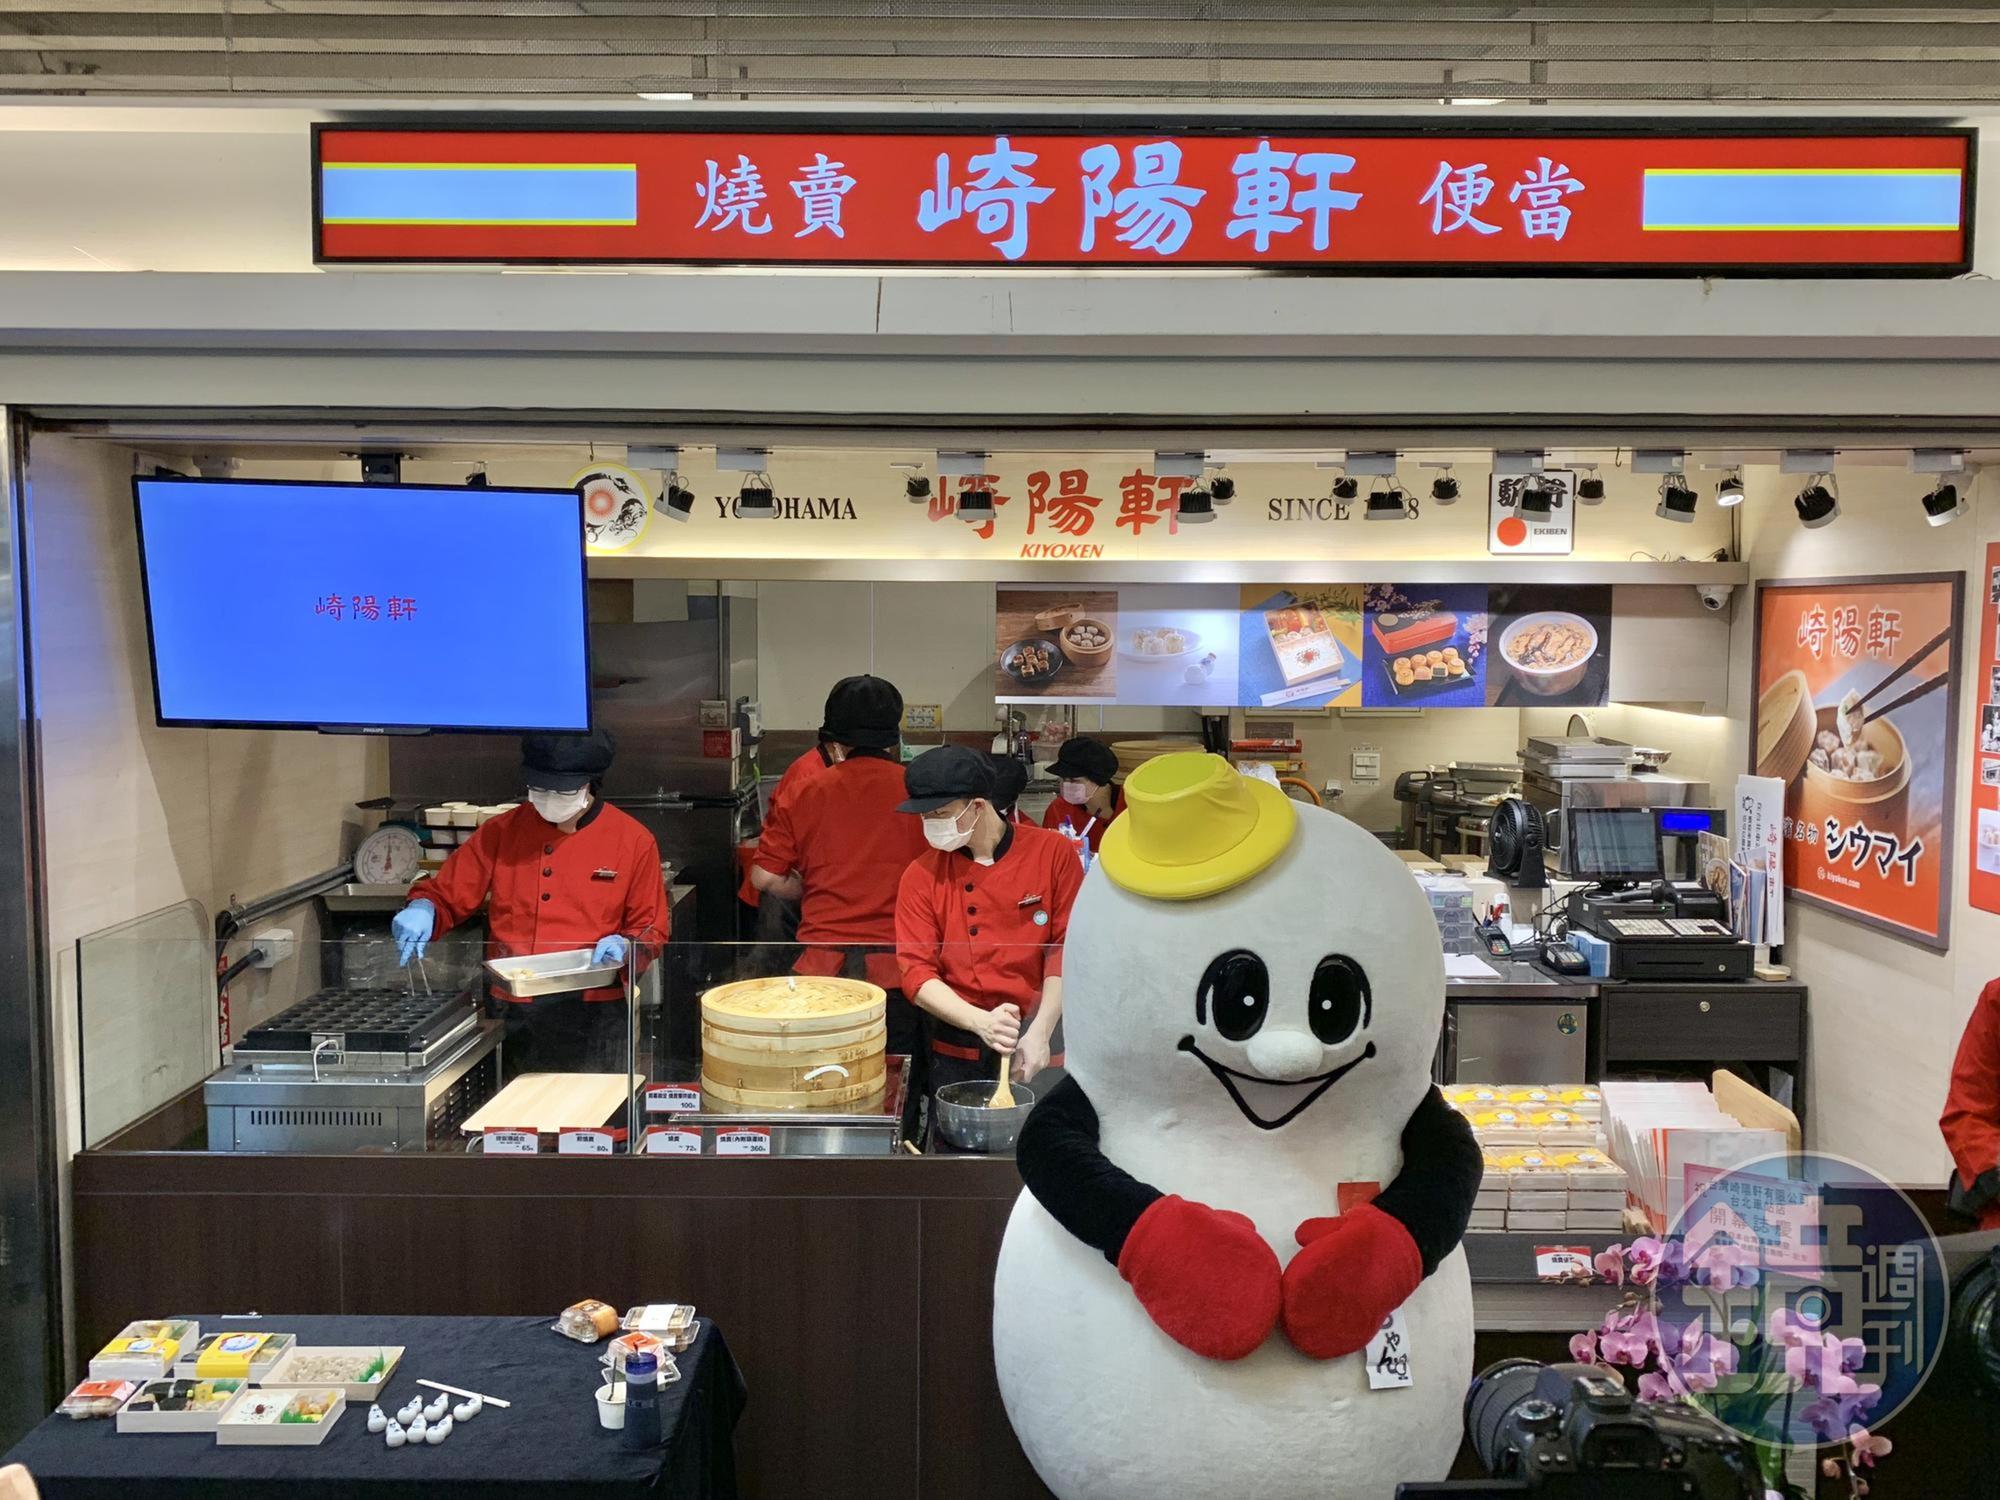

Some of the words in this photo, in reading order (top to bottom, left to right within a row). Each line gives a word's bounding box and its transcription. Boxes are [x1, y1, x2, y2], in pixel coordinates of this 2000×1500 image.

[694, 153, 857, 239] 燒賣
[917, 136, 1363, 260] 崎陽軒
[1420, 156, 1586, 242] 便當
[714, 496, 858, 520] YOOHAMA
[1268, 498, 1351, 521] SINCE
[1533, 527, 1568, 535] EKIBEN
[1020, 543, 1104, 559] KIYOKEN
[314, 594, 418, 621] 崎陽軒
[1797, 603, 1901, 659] 崎陽軒
[1825, 818, 1923, 884] シウマイ
